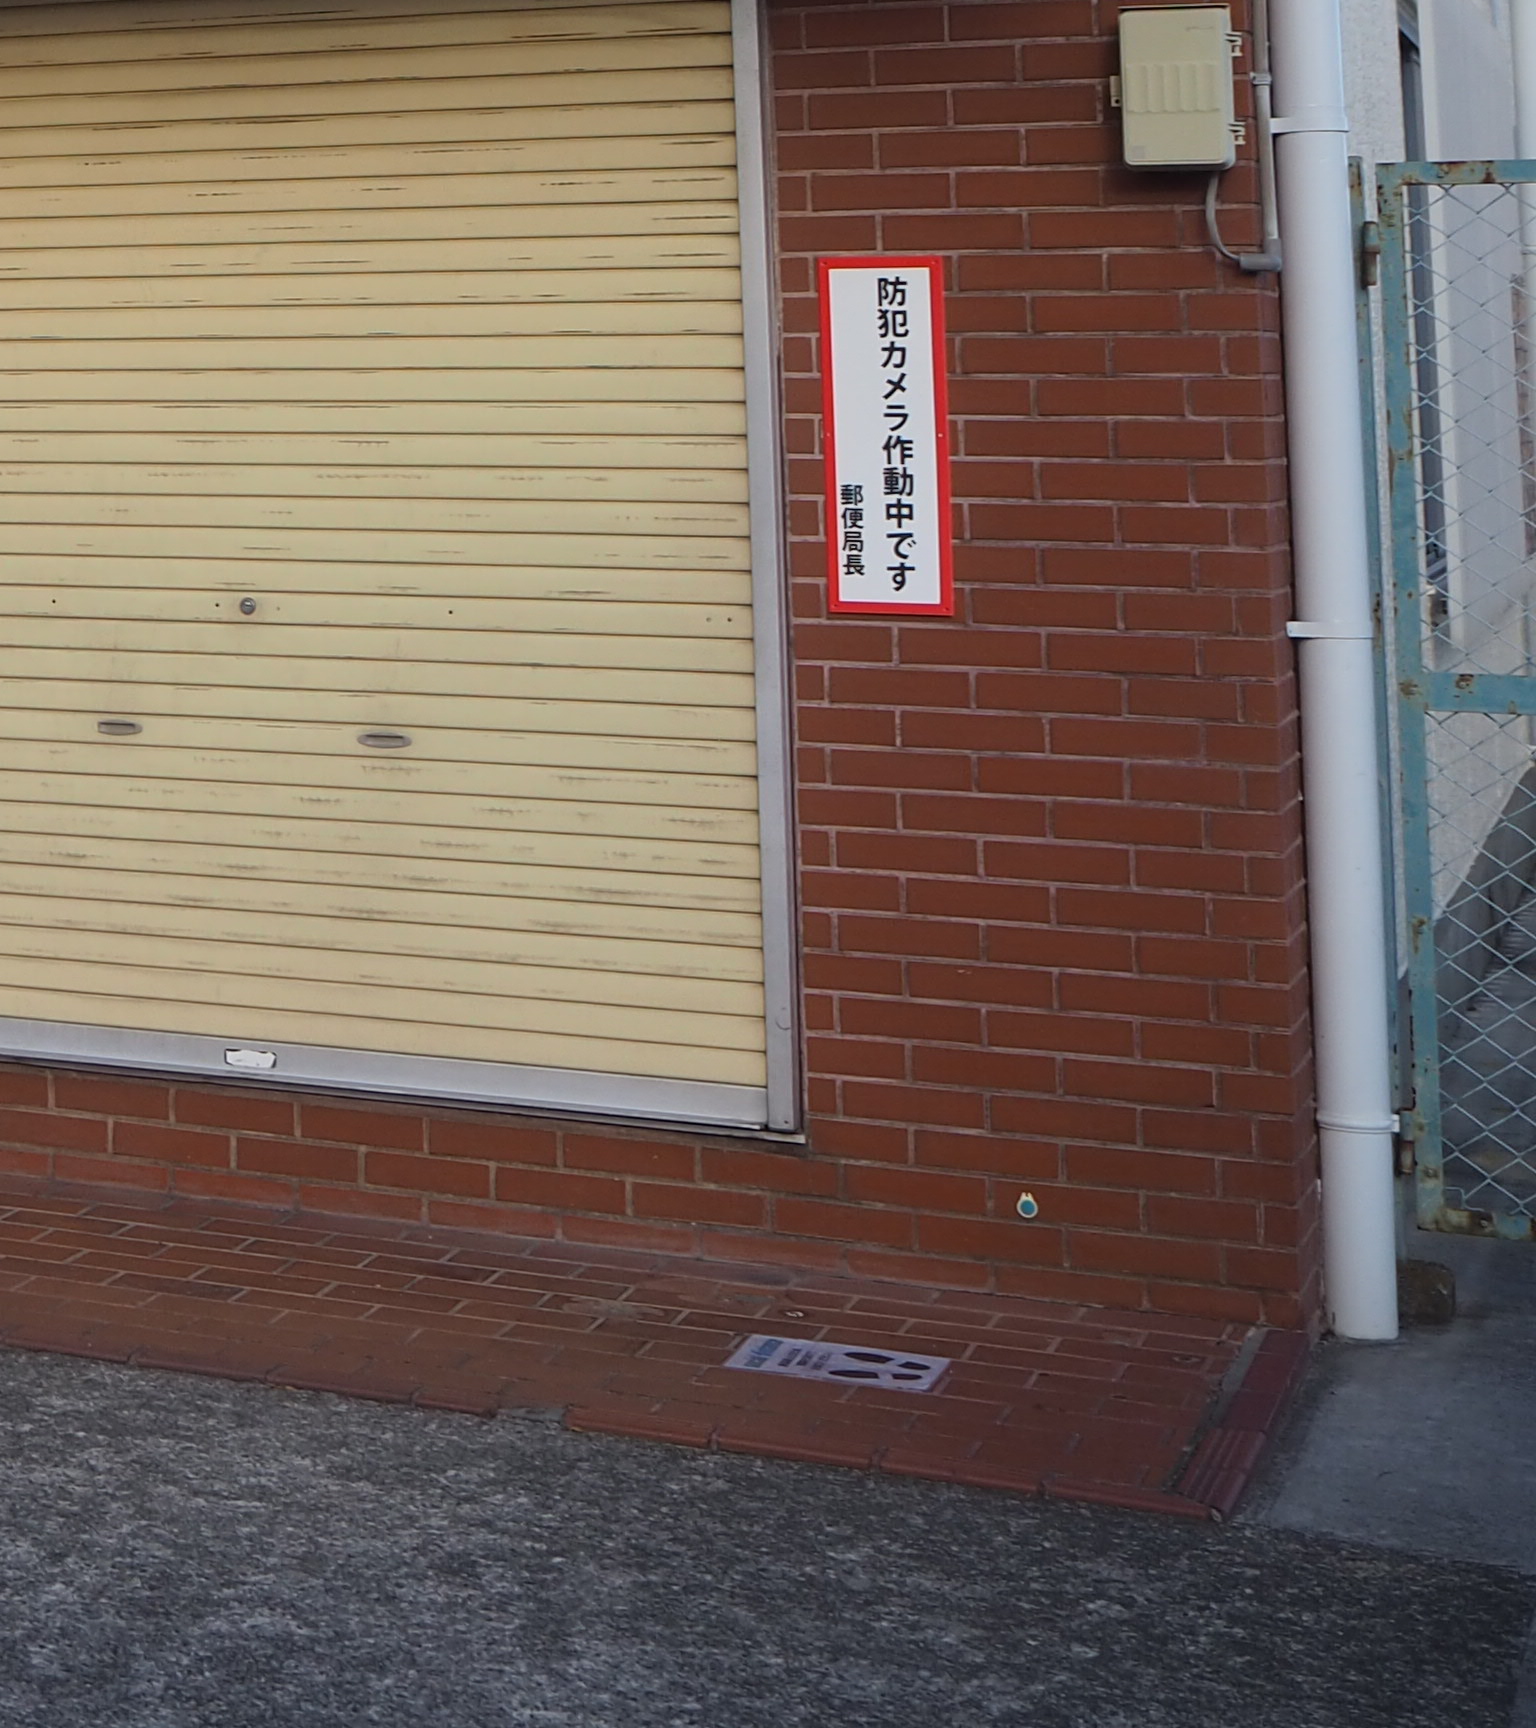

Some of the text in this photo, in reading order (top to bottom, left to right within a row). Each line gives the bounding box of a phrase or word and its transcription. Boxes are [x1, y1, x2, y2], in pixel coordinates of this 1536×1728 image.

[840, 484, 865, 576] 郵便局長
[877, 277, 916, 591] 防犯カメラ作動中です
